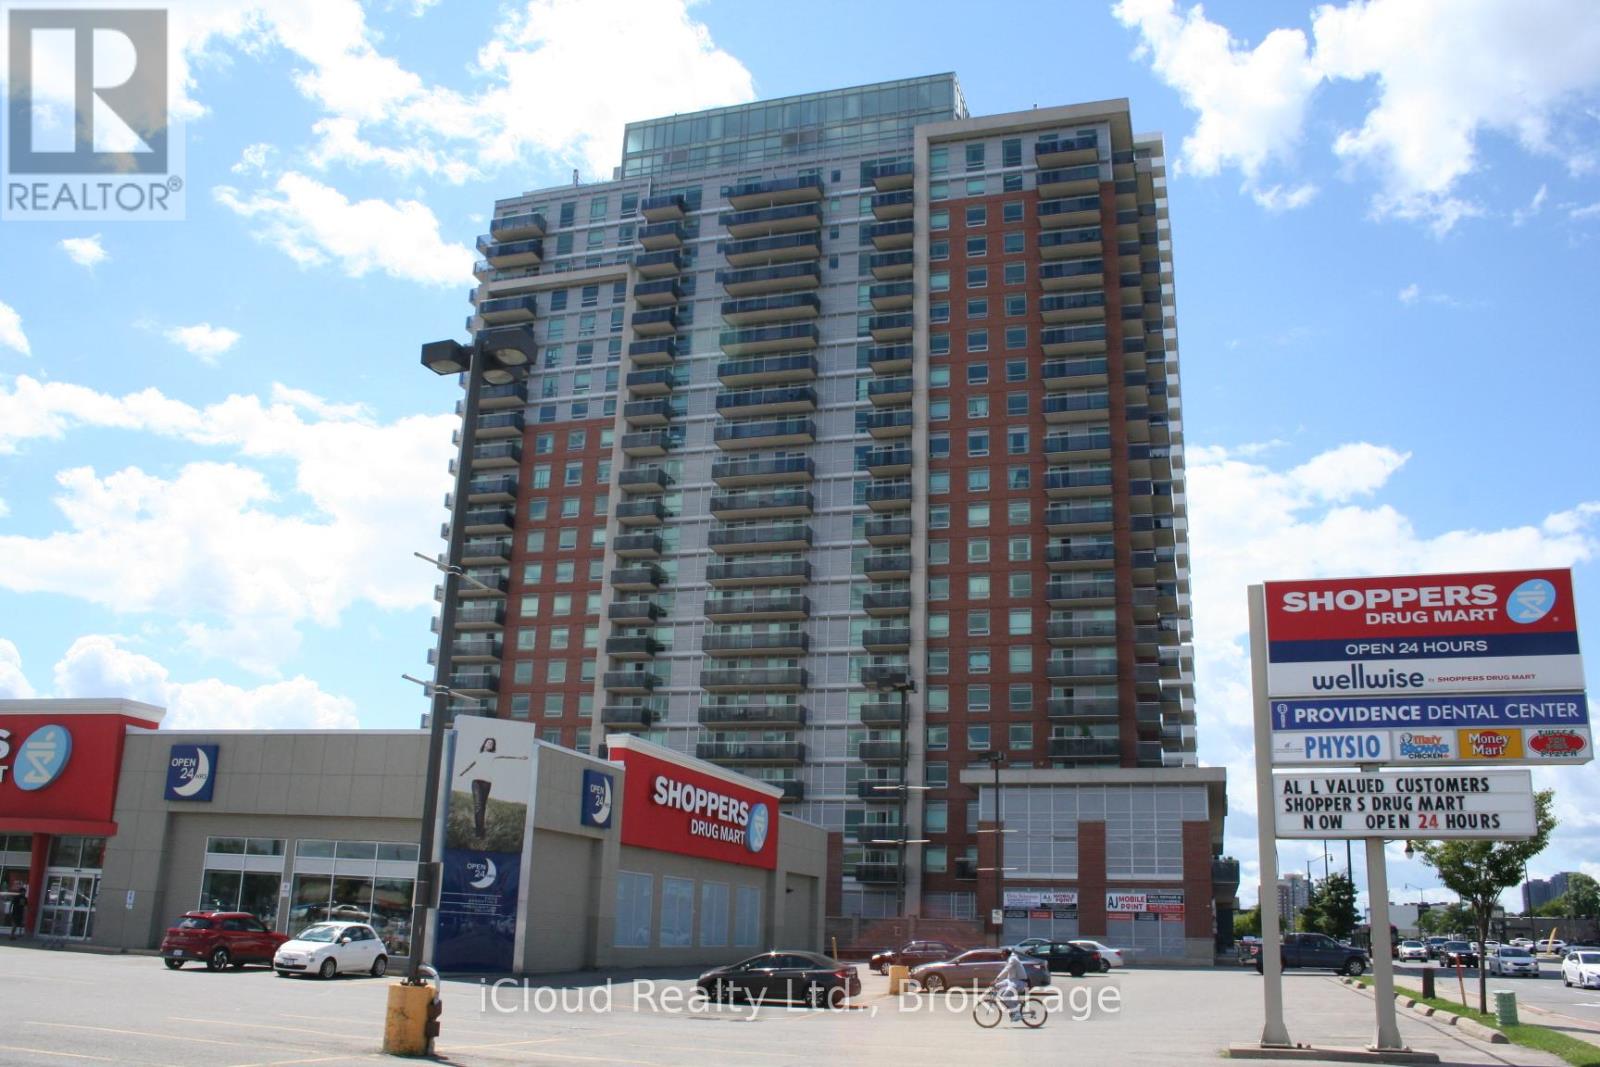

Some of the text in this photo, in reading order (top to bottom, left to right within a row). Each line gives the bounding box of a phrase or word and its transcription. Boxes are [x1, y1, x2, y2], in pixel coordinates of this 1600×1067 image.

[1282, 584, 1498, 613] SHOPPERS
[1365, 608, 1498, 625] DRUG MART
[1345, 640, 1488, 655] OPEN 24 HOURS
[1312, 663, 1424, 690] wellwise
[1437, 675, 1485, 683] SHOPPERS
[1294, 702, 1579, 723] PROVIDENCE DENTAL CENTER
[1304, 734, 1381, 759] PHYSIO
[1468, 733, 1510, 747] Money
[1472, 746, 1504, 756] Mart
[171, 758, 196, 767] OPEN
[179, 767, 194, 779] 24
[590, 783, 604, 795] OPEN
[1325, 779, 1384, 794] VALUED
[1396, 777, 1489, 793] CUSTOMERS
[595, 794, 603, 806] 24
[653, 775, 750, 827] SHOPPERS
[1372, 797, 1413, 811] DRUG
[1418, 795, 1465, 811] MART
[1365, 814, 1410, 829] OPEN
[1418, 814, 1439, 829] 24
[1446, 813, 1500, 829] HOURS
[691, 819, 746, 845] DRUG MART
[474, 869, 486, 878] 24
[1107, 896, 1119, 908] AJ
